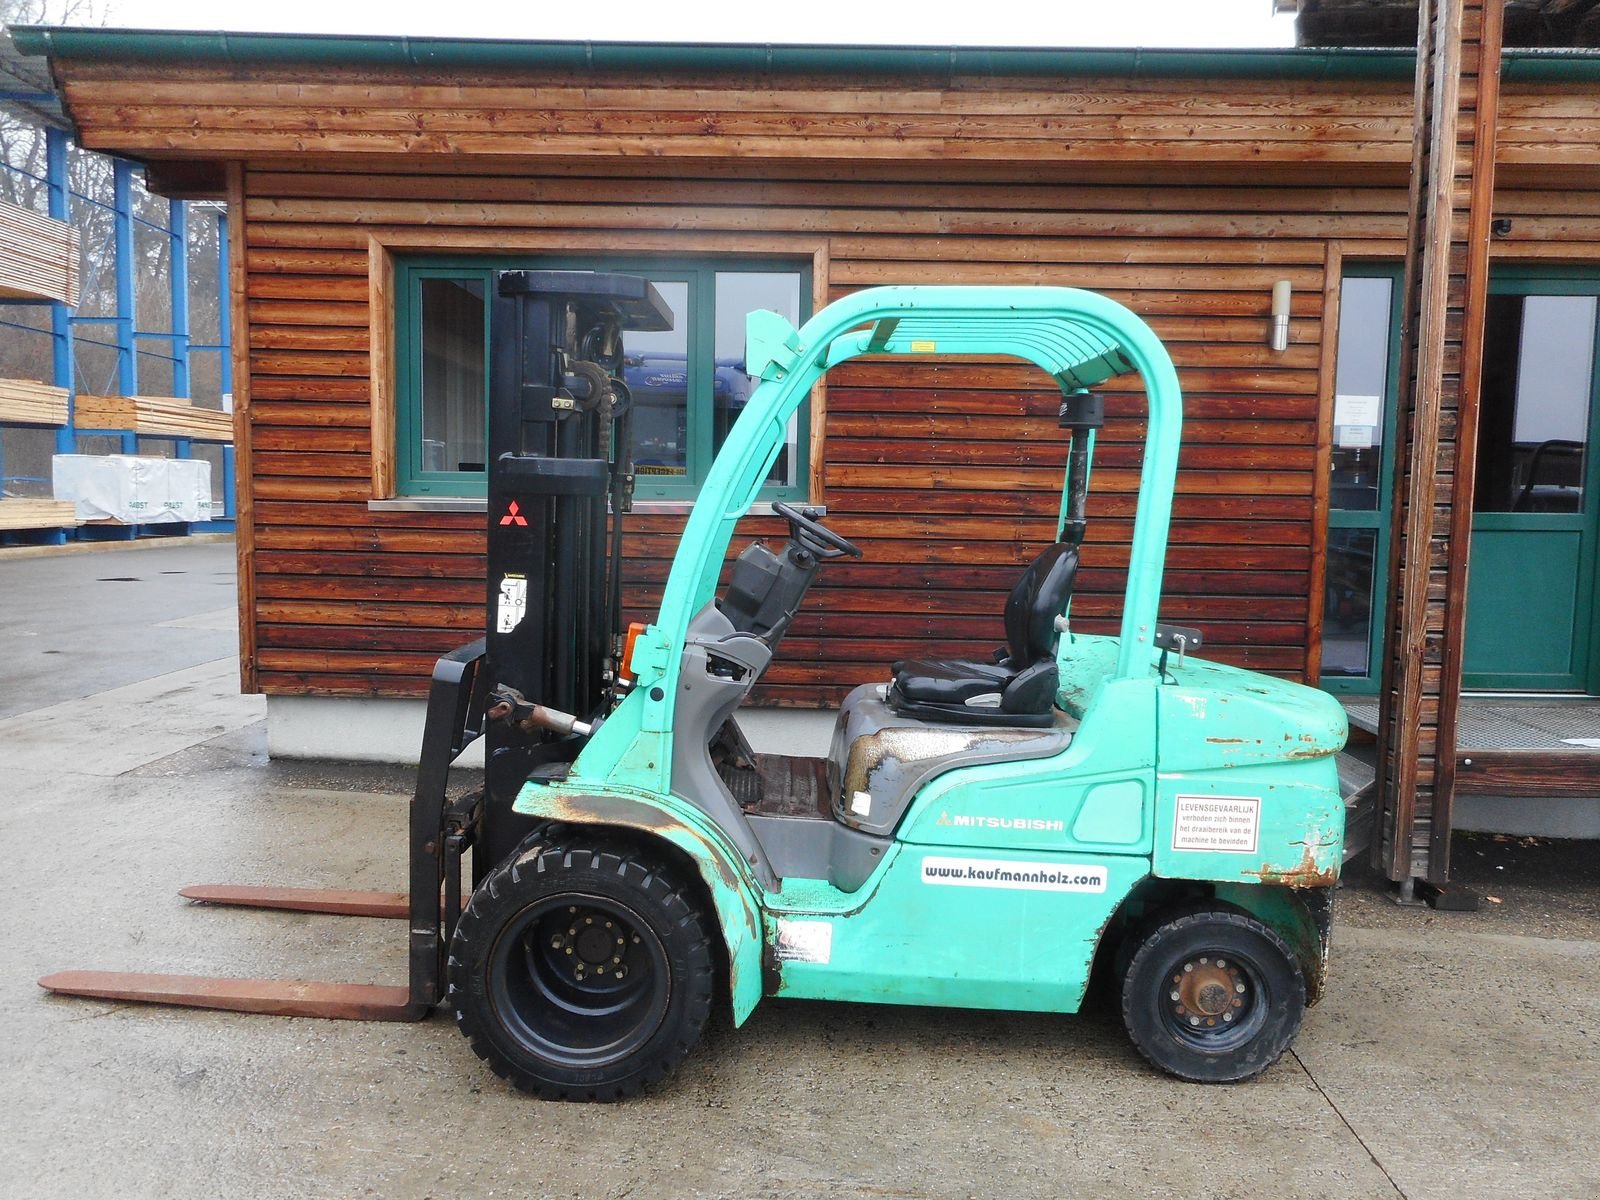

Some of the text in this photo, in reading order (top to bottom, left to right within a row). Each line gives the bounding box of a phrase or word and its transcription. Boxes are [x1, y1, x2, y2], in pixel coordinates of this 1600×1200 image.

[1180, 803, 1255, 814] LEVENSGEVAARLIJK
[953, 815, 1064, 831] MITSUBISHI
[1182, 814, 1251, 824] verboden zich binnen
[1243, 827, 1252, 835] de
[1181, 836, 1209, 844] machine
[1218, 837, 1248, 846] bevinden
[925, 866, 1101, 886] www.kaufmannholz.com
